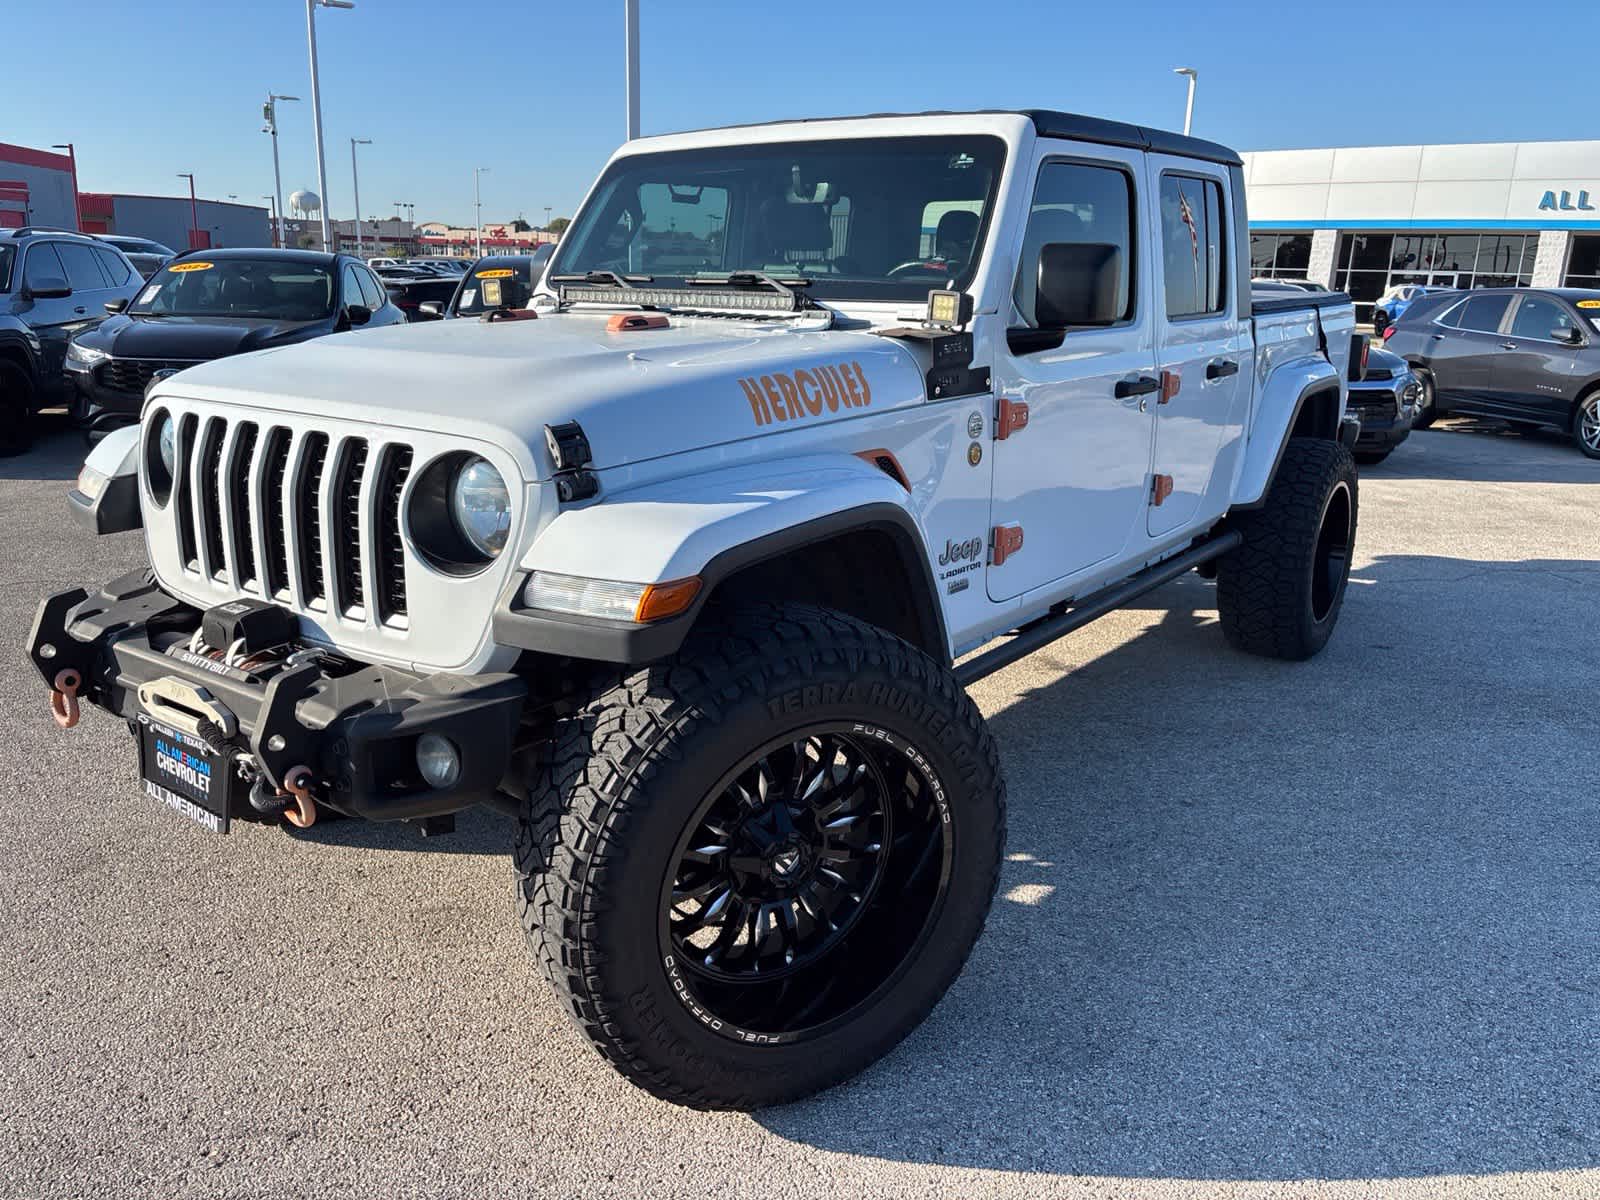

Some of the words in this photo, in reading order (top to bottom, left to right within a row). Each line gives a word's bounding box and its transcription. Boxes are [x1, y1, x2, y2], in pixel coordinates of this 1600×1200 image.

[1538, 190, 1596, 211] ALL
[737, 360, 872, 427] HERCULES
[938, 537, 982, 566] Jeep
[182, 652, 231, 676] SMITTYBILT
[767, 681, 858, 719] TERRA
[868, 681, 954, 744] HUNTER
[155, 739, 171, 757] ALL
[171, 745, 211, 777] AMERICAN
[156, 751, 211, 794] CHEVROLET
[853, 723, 894, 744] FUEL
[905, 746, 951, 824] OFF-ROAD
[146, 780, 164, 802] ALL
[165, 790, 218, 833] AMERICAN
[664, 954, 723, 1031] OFF-ROAD
[736, 1029, 781, 1043] FUEL
